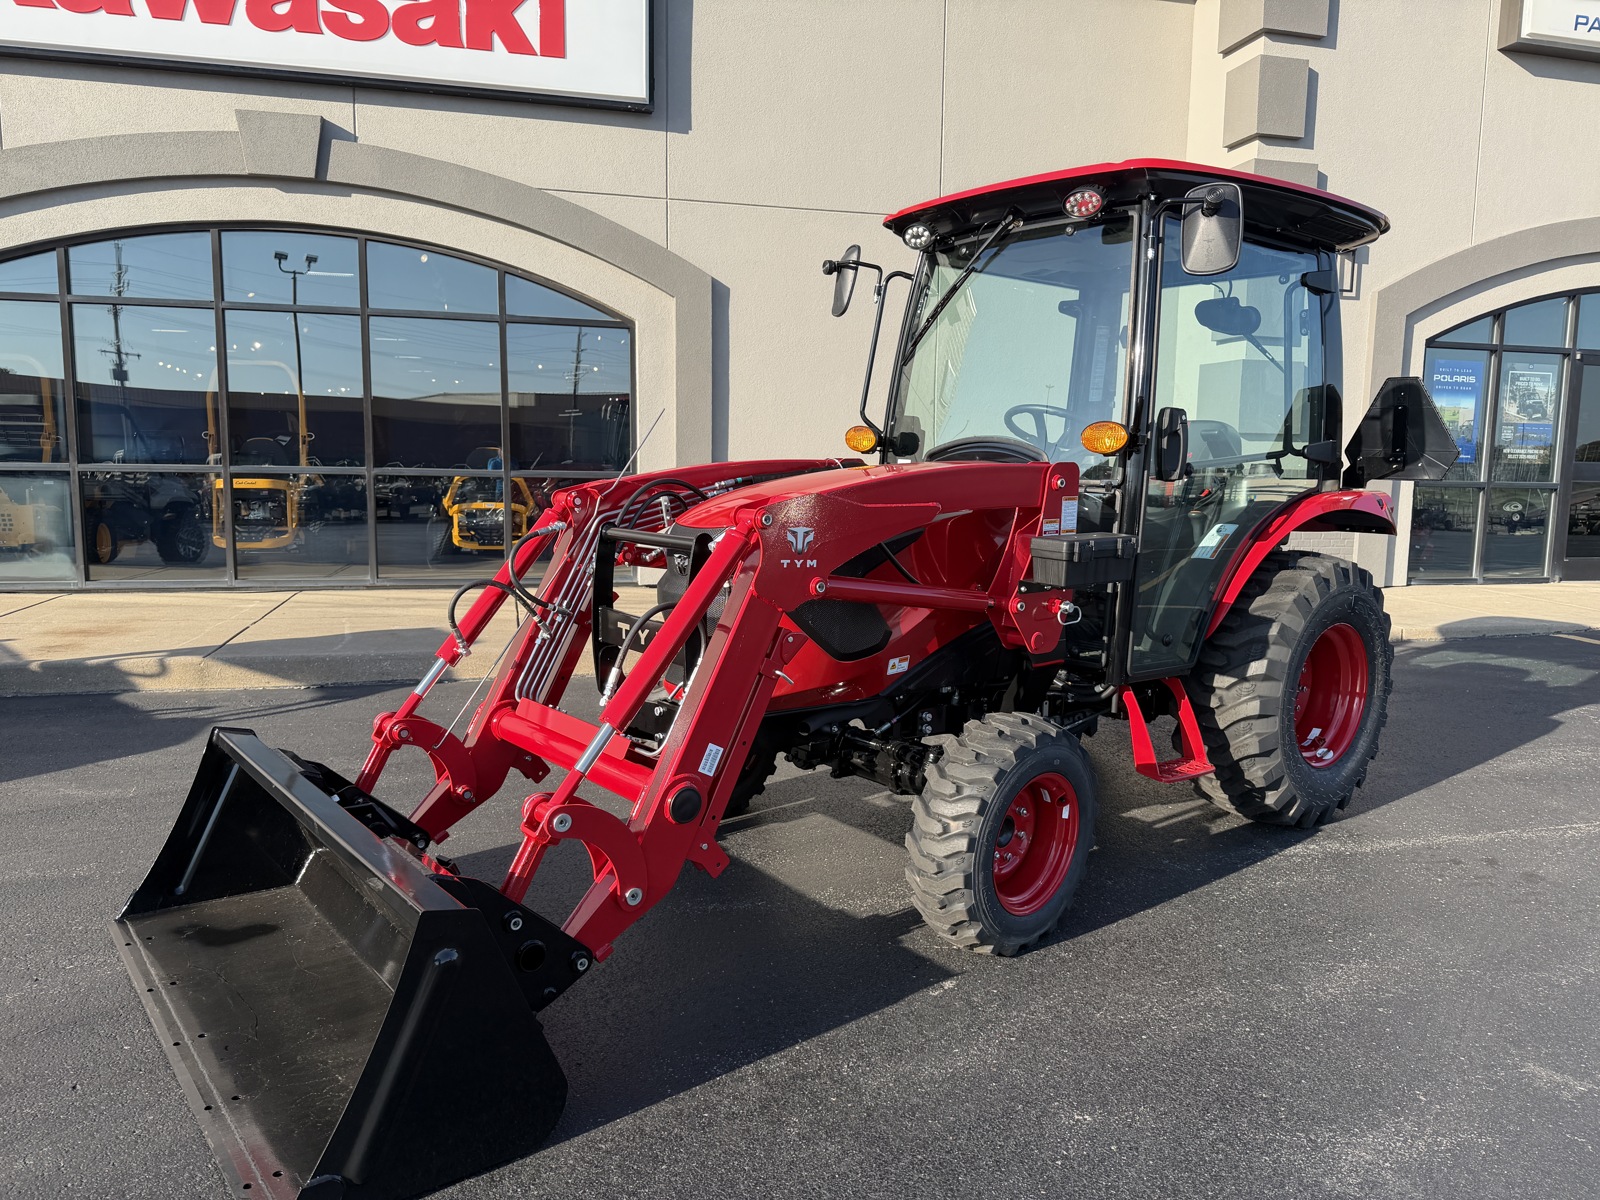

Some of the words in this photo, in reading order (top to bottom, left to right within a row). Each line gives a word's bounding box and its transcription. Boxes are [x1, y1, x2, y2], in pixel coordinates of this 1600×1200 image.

[14, 0, 566, 58] asaki
[1433, 374, 1476, 383] POLARIS
[780, 559, 817, 568] TYM
[617, 621, 660, 645] TY
